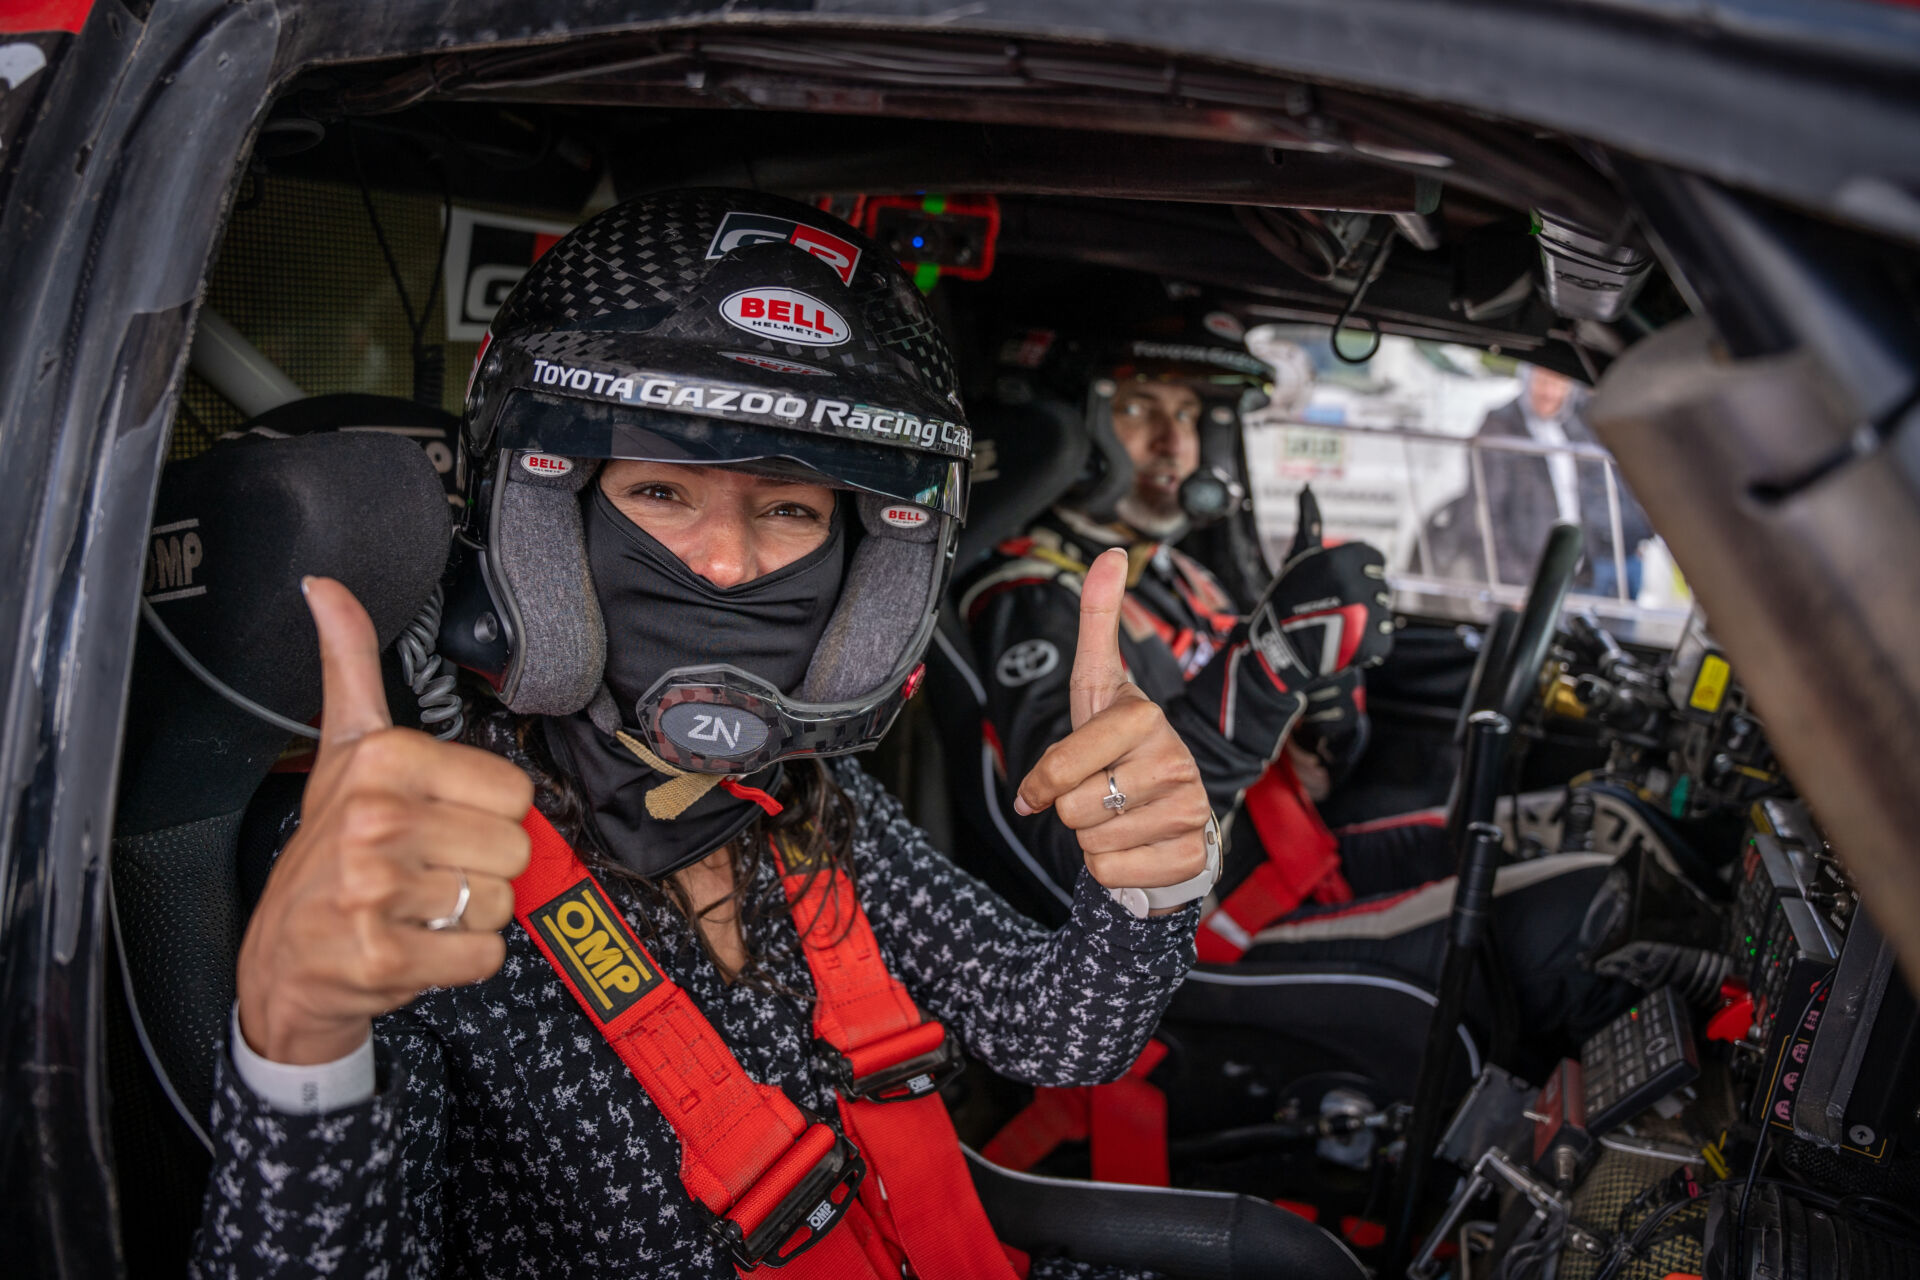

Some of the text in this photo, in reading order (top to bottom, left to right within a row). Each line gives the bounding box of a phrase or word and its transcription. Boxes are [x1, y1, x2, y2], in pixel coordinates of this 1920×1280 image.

[740, 297, 834, 335] BELL
[752, 320, 822, 339] HELMETS
[533, 360, 634, 399] TOYOTA
[639, 379, 807, 418] GAZOO
[811, 398, 937, 447] Racing
[529, 456, 566, 470] BELL
[888, 510, 923, 521] BELL
[557, 901, 640, 993] OMP
[909, 1075, 932, 1090] OMP
[810, 1202, 832, 1228] OMP
